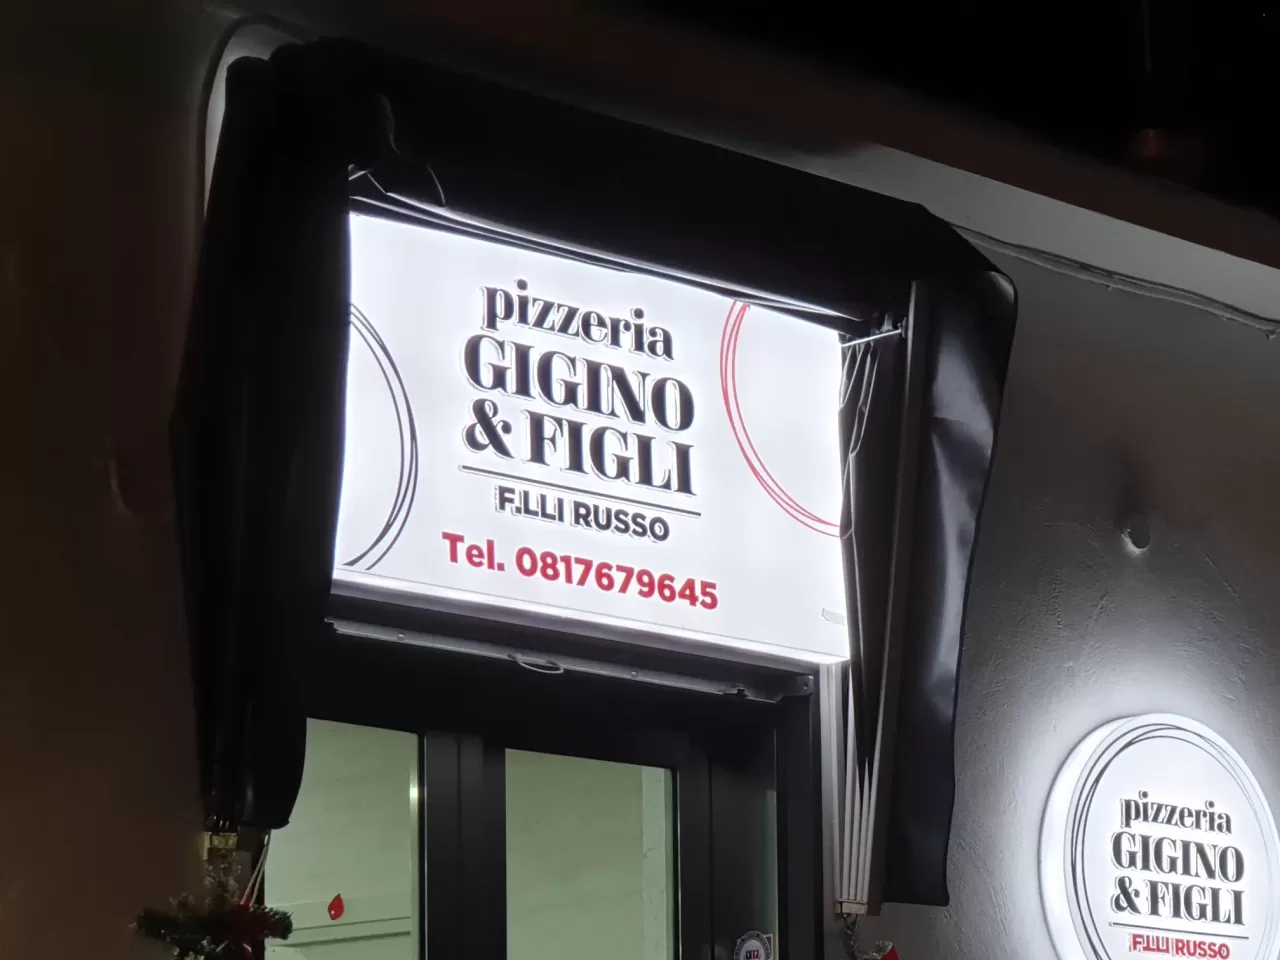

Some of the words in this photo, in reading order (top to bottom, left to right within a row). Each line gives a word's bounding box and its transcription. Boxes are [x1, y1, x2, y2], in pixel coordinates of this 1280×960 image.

[481, 278, 674, 361] pizzeria
[463, 333, 695, 433] GIGINO
[462, 397, 515, 460] &
[524, 407, 698, 498] FIGLI
[495, 485, 566, 523] F.LLI
[573, 499, 671, 543] RUSSO
[441, 531, 506, 573] Tel.
[515, 545, 720, 610] 0817679645
[1120, 789, 1232, 834] pizzeria
[1111, 830, 1245, 883] GIGINO
[1112, 875, 1141, 914] &
[1146, 880, 1246, 926] FIGLI
[1175, 938, 1231, 960] RUSSO
